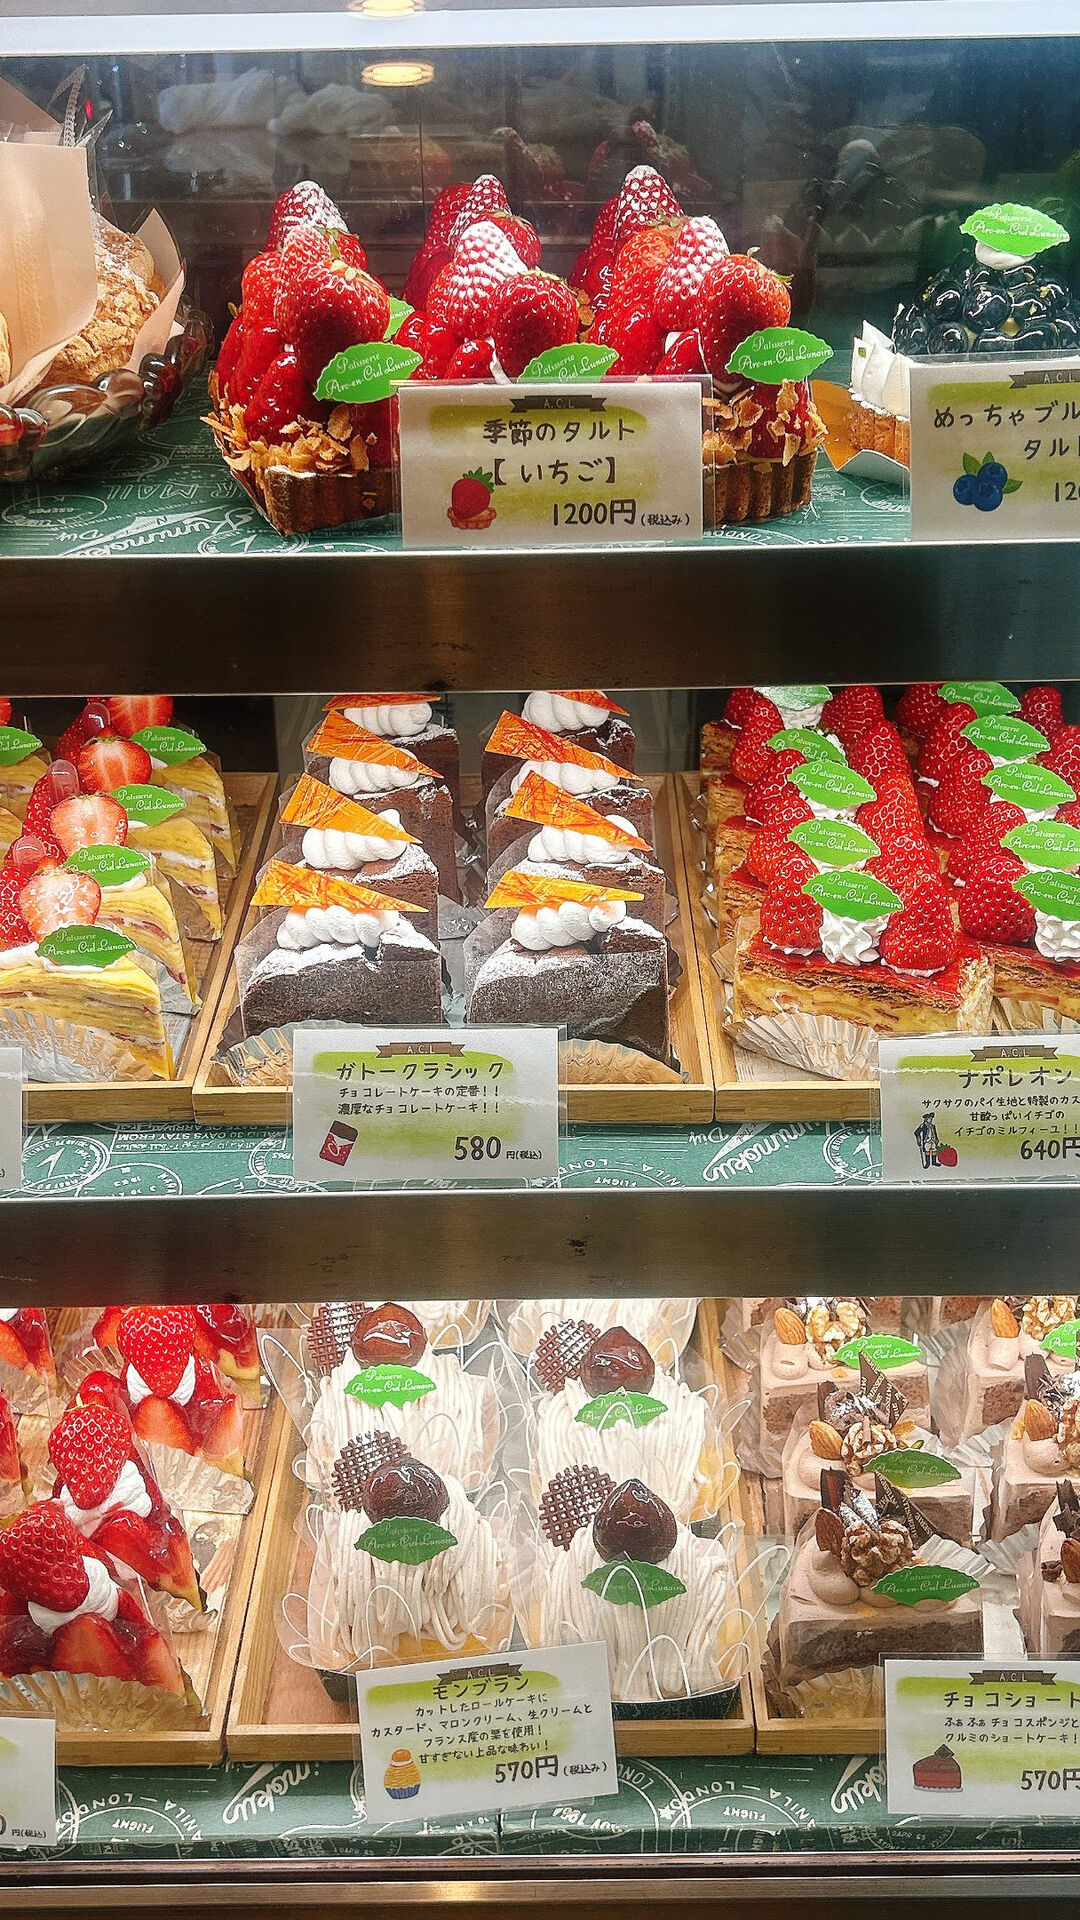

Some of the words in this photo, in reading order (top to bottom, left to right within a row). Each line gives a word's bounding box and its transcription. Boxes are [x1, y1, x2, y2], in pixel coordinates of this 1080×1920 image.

[752, 336, 794, 352] Patisserie
[336, 353, 380, 374] Patisserie
[532, 354, 575, 377] Patisserie
[580, 352, 616, 374] Lunaire
[738, 348, 794, 370] Arc-en-Ciel
[796, 345, 832, 359] Lunaire
[325, 363, 383, 397] Arc-en-Ciel
[384, 357, 421, 374] Lunaire
[483, 418, 635, 447] 季節のタルト
[493, 457, 617, 485] 【いちご】
[1054, 481, 1080, 502] 12
[553, 499, 637, 526] 1200円
[989, 696, 1020, 710] Lunaire
[984, 718, 1020, 733] Patisserie
[11, 739, 42, 750] Lunaire
[141, 731, 176, 743] Patisserie
[969, 728, 1015, 744] Arc-en-Ciel
[1015, 734, 1049, 749] Lunaire
[175, 741, 206, 752] Lunaire
[809, 763, 847, 781] Patisserie
[1005, 765, 1044, 782] Patisserie
[795, 773, 841, 793] Arc-en-Ciel
[841, 784, 875, 799] Lunaire
[990, 775, 1038, 794] Arc-en-Ciel
[1039, 784, 1076, 800] Lunaire
[117, 790, 153, 801] Patisserie
[154, 799, 186, 810] Lunaire
[809, 823, 847, 838] Patisserie
[1025, 824, 1066, 838] Patisserie
[796, 832, 844, 850] Arc-en-Ciel
[844, 841, 880, 855] Lunaire
[1009, 835, 1062, 850] Arc-en-Ciel
[78, 850, 115, 862] Patisserie
[115, 860, 149, 870] Lunaire
[827, 873, 868, 890] Patisserie
[811, 884, 864, 904] Arc-en-Ciel
[864, 893, 902, 909] Lunaire
[1021, 882, 1075, 905] Arc-en-Ciel
[56, 932, 96, 942] Patisserie
[44, 941, 96, 957] Arc-en-Ciel
[97, 940, 134, 952] Lunaire
[336, 1062, 504, 1080] ガトークラシック
[958, 1065, 1072, 1089] ナポレオン
[970, 1111, 1065, 1122] 甘酸っぱいイチゴの
[117, 1133, 155, 1141] FROM
[454, 1136, 501, 1160] 580
[1020, 1137, 1080, 1160] 640円
[857, 1339, 892, 1350] Patisserie
[890, 1348, 920, 1358] Lunaire
[365, 1369, 403, 1381] Patisserie
[351, 1379, 400, 1394] Arc-en-Ciel
[401, 1379, 434, 1390] Lunaire
[633, 1404, 666, 1416] Lunaire
[900, 1571, 942, 1581] Patisserie
[882, 1581, 939, 1593] Arc-en-Ciel
[941, 1579, 978, 1589] Lunaire
[432, 1676, 530, 1700] モンブラン
[415, 1693, 548, 1717] カットしたロールケーキに
[944, 1691, 1080, 1708] チョコショート
[371, 1703, 593, 1738] カスタード、マロンクリーム、生クリームと
[495, 1755, 558, 1784] 570円
[1020, 1767, 1080, 1791] 570円
[164, 1799, 203, 1841] ANILA
[722, 1805, 766, 1821] FLIGHT
[110, 1818, 155, 1834] FLIGHT
